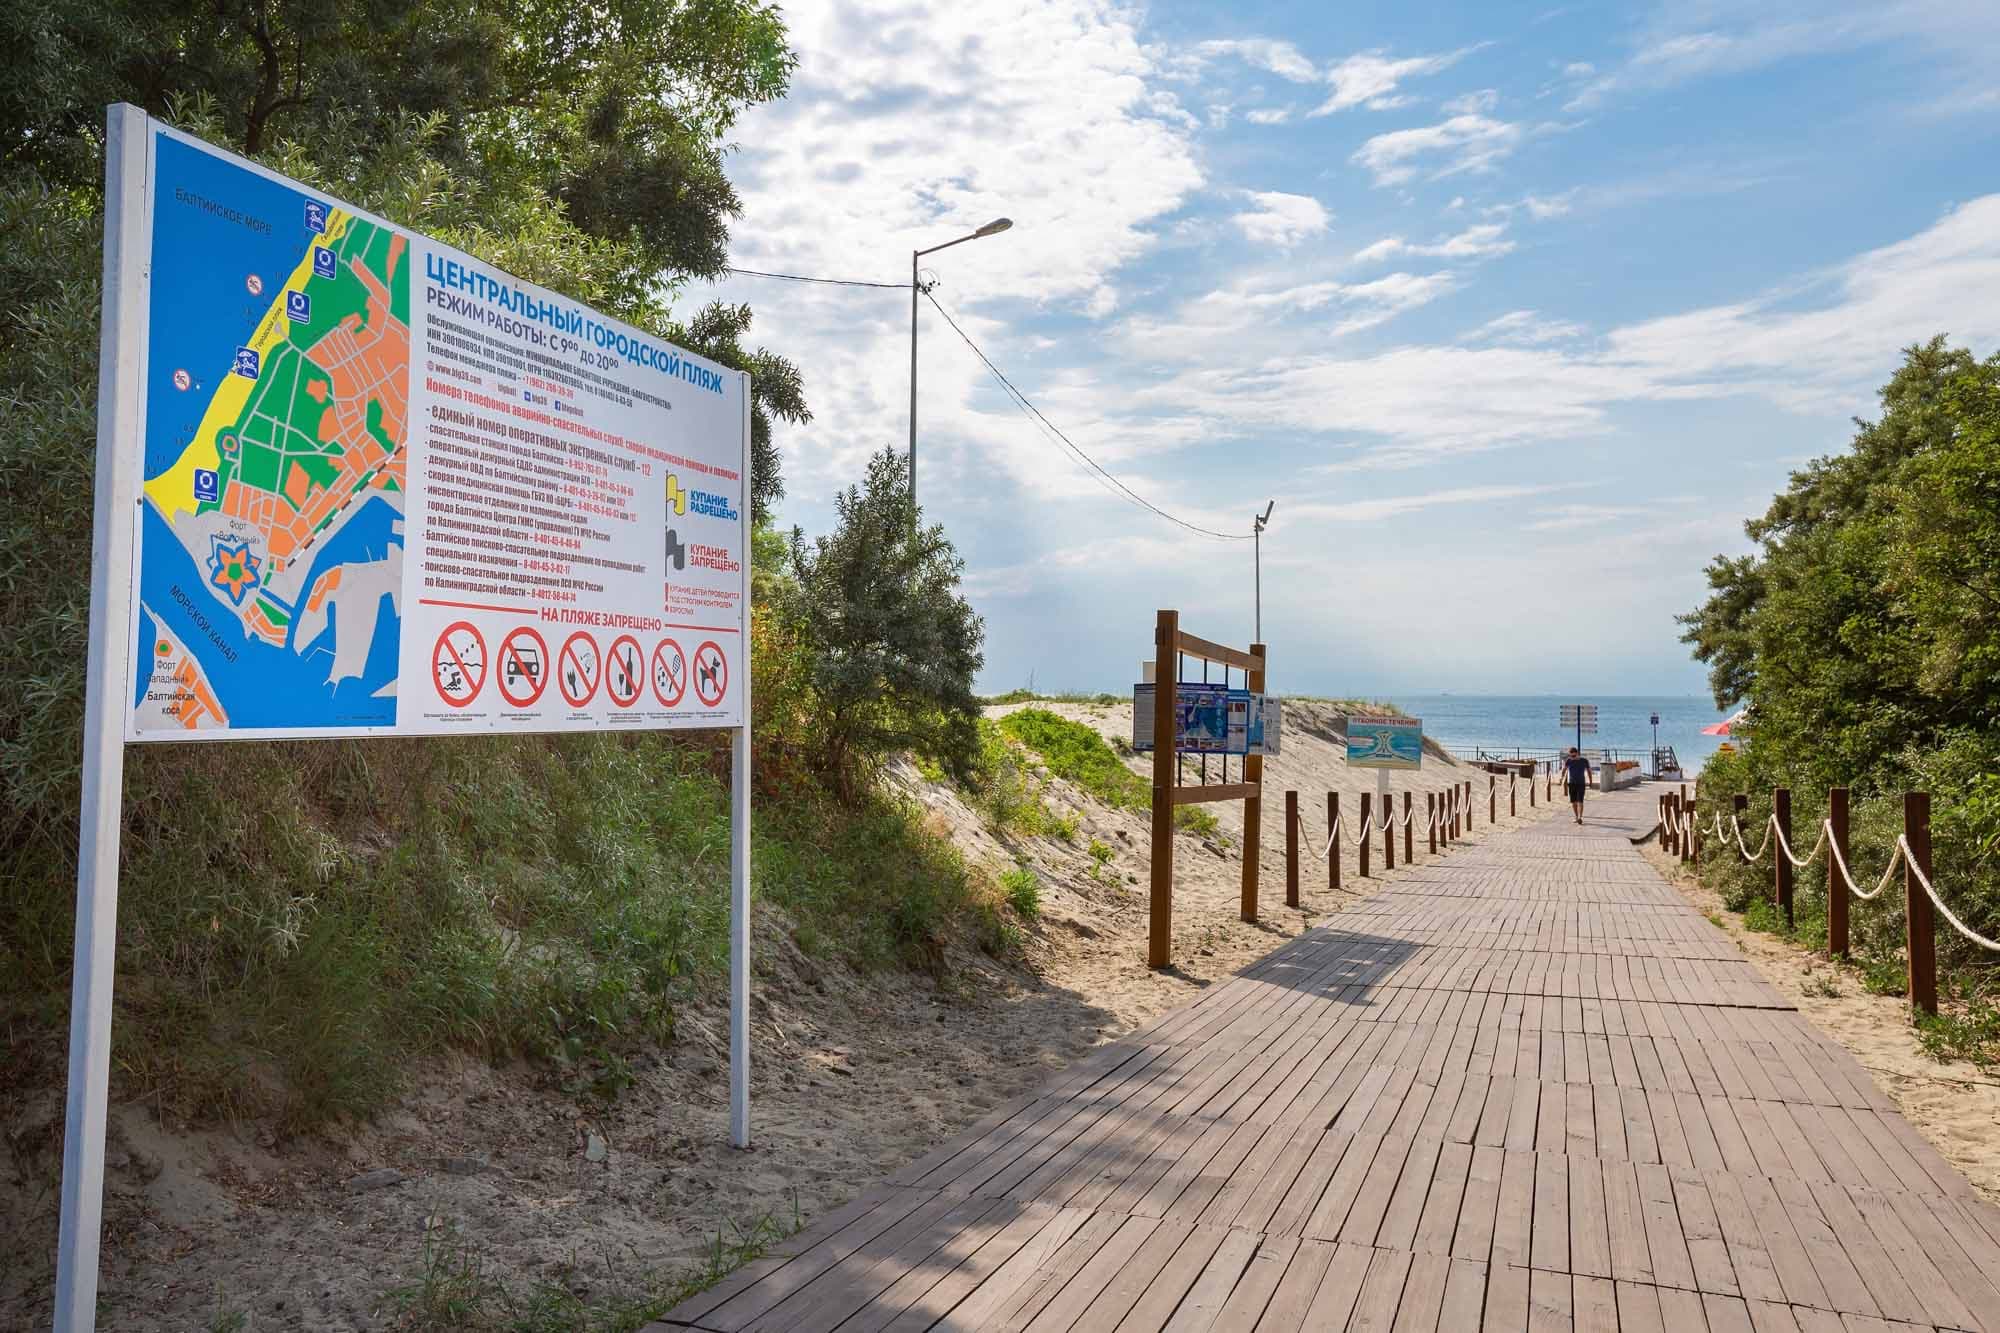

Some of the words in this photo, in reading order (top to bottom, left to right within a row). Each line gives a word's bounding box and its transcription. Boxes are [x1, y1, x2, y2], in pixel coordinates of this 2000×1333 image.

[175, 188, 242, 224] БАЛТИЙСКОЕ
[244, 215, 272, 234] МОРЕ
[425, 254, 582, 336] ЦЕНТРАЛЬНЫЙ
[586, 321, 679, 377] ГОРОДСКОЙ
[682, 361, 722, 394] ПЛЯЖ
[426, 286, 484, 322] РЕЖИМ
[487, 310, 546, 347] РАБОТЫ:
[549, 334, 558, 350] С
[426, 313, 484, 342] Обслуживающая
[525, 350, 572, 373] МУНИЦИПАЛЬНОЕ
[426, 341, 458, 361] Телефон
[458, 354, 495, 374] менеджера
[496, 367, 516, 381] пляжа
[427, 327, 440, 341] ИНН
[527, 363, 541, 375] ОГРН
[426, 377, 461, 399] Номера
[463, 390, 509, 413] телефонов
[512, 405, 602, 440] аварийно-спасательных
[429, 424, 479, 444] спасательная
[481, 437, 508, 451] станция
[509, 444, 530, 457] города
[532, 448, 563, 466] Балтийска
[431, 405, 474, 427] единый
[476, 417, 506, 436] номер
[508, 426, 566, 451] оперативных
[568, 443, 612, 465] экстренных
[614, 456, 635, 472] служб
[641, 463, 651, 476] 112
[428, 455, 468, 471] дежурный
[469, 462, 483, 476] ОВД
[494, 467, 536, 487] Балтийскому
[537, 479, 558, 492] району
[429, 439, 478, 458] оперативный
[479, 452, 515, 467] дежурный
[534, 464, 579, 482] администрации
[428, 470, 454, 483] скорая
[455, 476, 503, 493] медицинская
[504, 486, 530, 499] помощь
[690, 490, 727, 508] КУПАНИЕ
[427, 485, 482, 503] инспекторское
[484, 496, 519, 511] отделение
[529, 505, 569, 520] маломерным
[570, 514, 587, 524] судам
[427, 500, 453, 513] города
[455, 503, 492, 520] Балтийска
[493, 511, 516, 525] Центра
[517, 515, 533, 527] ГИМС
[580, 527, 591, 538] МЧС
[592, 529, 610, 542] России
[690, 501, 737, 520] РАЗРЕШЕНО
[229, 520, 248, 530] Форт
[438, 516, 500, 536] Калининградской
[502, 527, 528, 541] области
[425, 546, 477, 562] специального
[478, 554, 517, 567] назначения
[426, 529, 469, 546] Балтийское
[471, 538, 548, 558] поисково-спасательное
[549, 550, 593, 565] подразделение
[690, 544, 727, 559] КУПАНИЕ
[690, 555, 739, 572] ЗАПРЕЩЕНО
[424, 562, 509, 580] поисково-спасательное
[510, 573, 560, 587] подразделение
[572, 579, 583, 589] МЧС
[584, 581, 603, 592] России
[435, 577, 497, 593] Калининградской
[499, 584, 525, 597] области
[170, 584, 210, 634] МОРСКОЙ
[208, 630, 238, 663] КАНАЛ
[541, 607, 558, 621] НА
[560, 609, 600, 625] ПЛЯЖЕ
[602, 613, 661, 631] ЗАПРЕЩЕНО
[156, 660, 175, 671] Форт
[147, 689, 195, 703] Балтийская
[161, 706, 180, 715] коса
